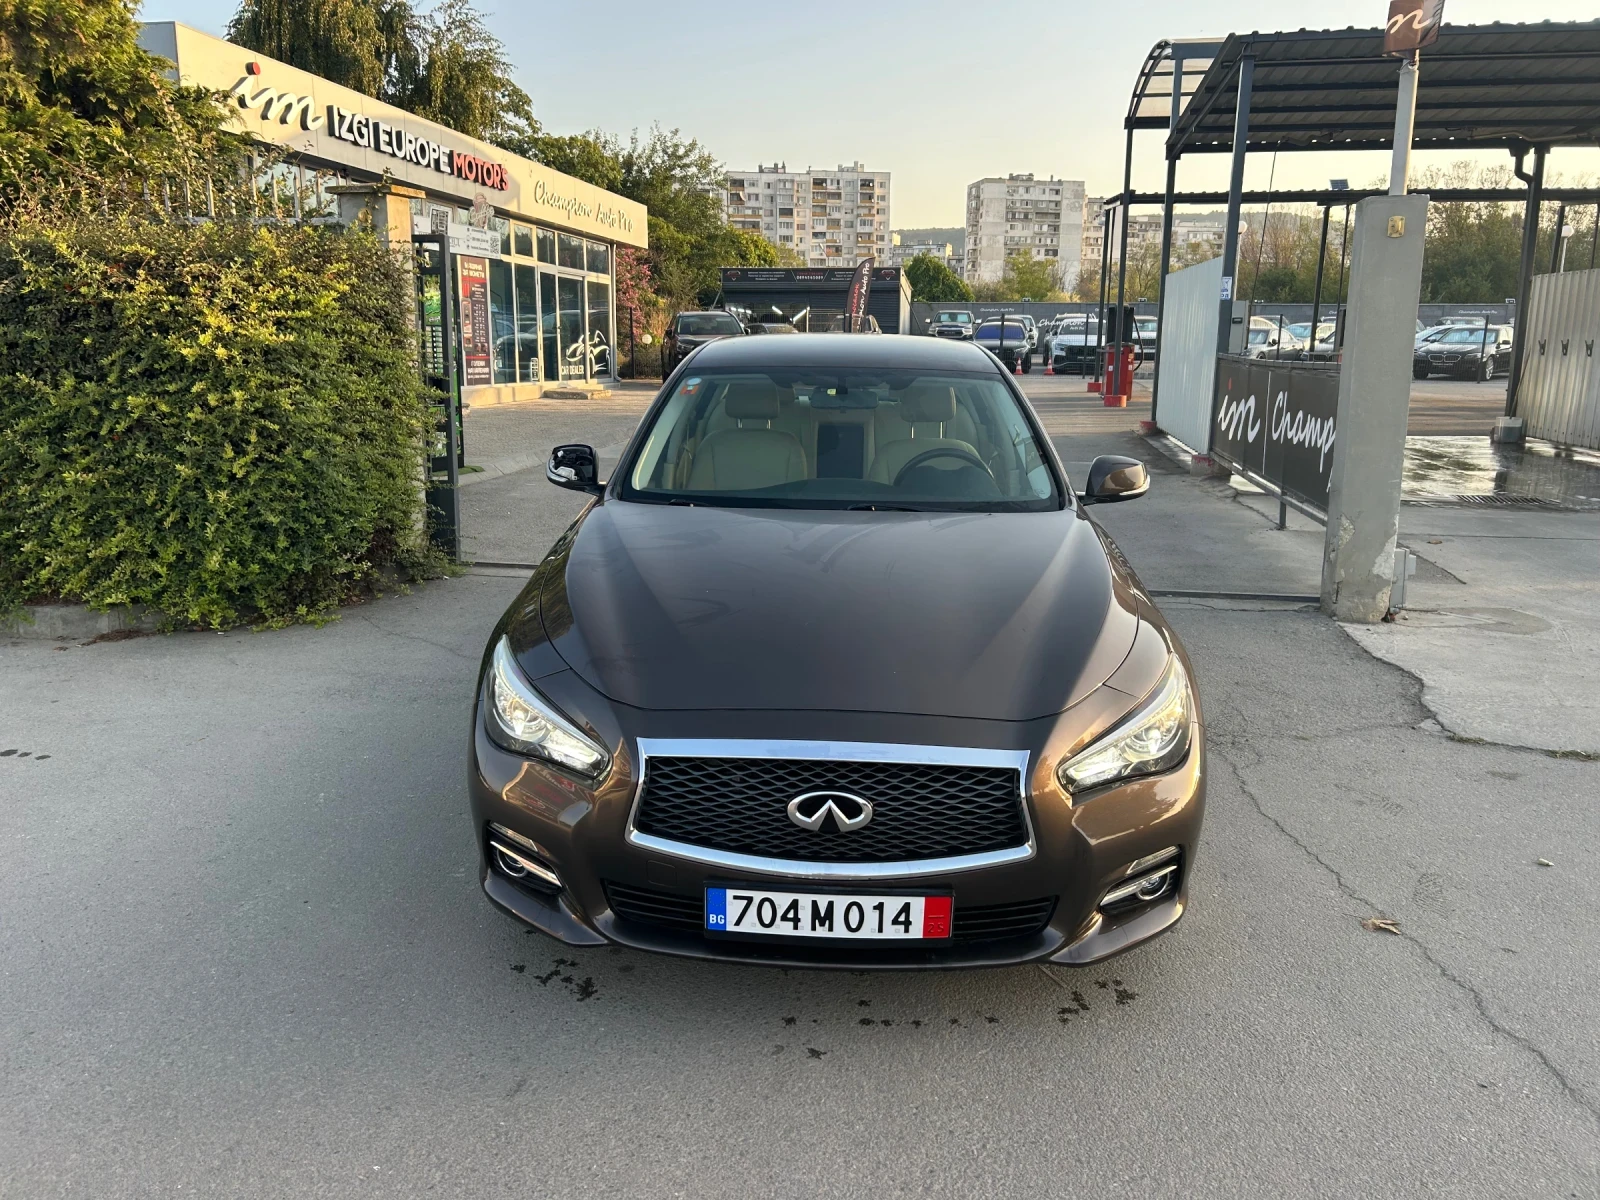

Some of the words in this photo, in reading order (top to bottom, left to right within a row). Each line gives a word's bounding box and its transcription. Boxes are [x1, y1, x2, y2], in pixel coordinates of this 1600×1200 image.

[328, 105, 375, 148] IZGI
[376, 121, 451, 174] EUROPE
[534, 179, 593, 220] Champion
[595, 202, 618, 228] Auto
[618, 209, 633, 233] Pro
[862, 262, 871, 276] Pro
[860, 276, 869, 295] Auto
[561, 366, 569, 375] CAR
[570, 365, 585, 375] DEALER
[1272, 391, 1336, 474] Champ
[709, 913, 725, 925] BG
